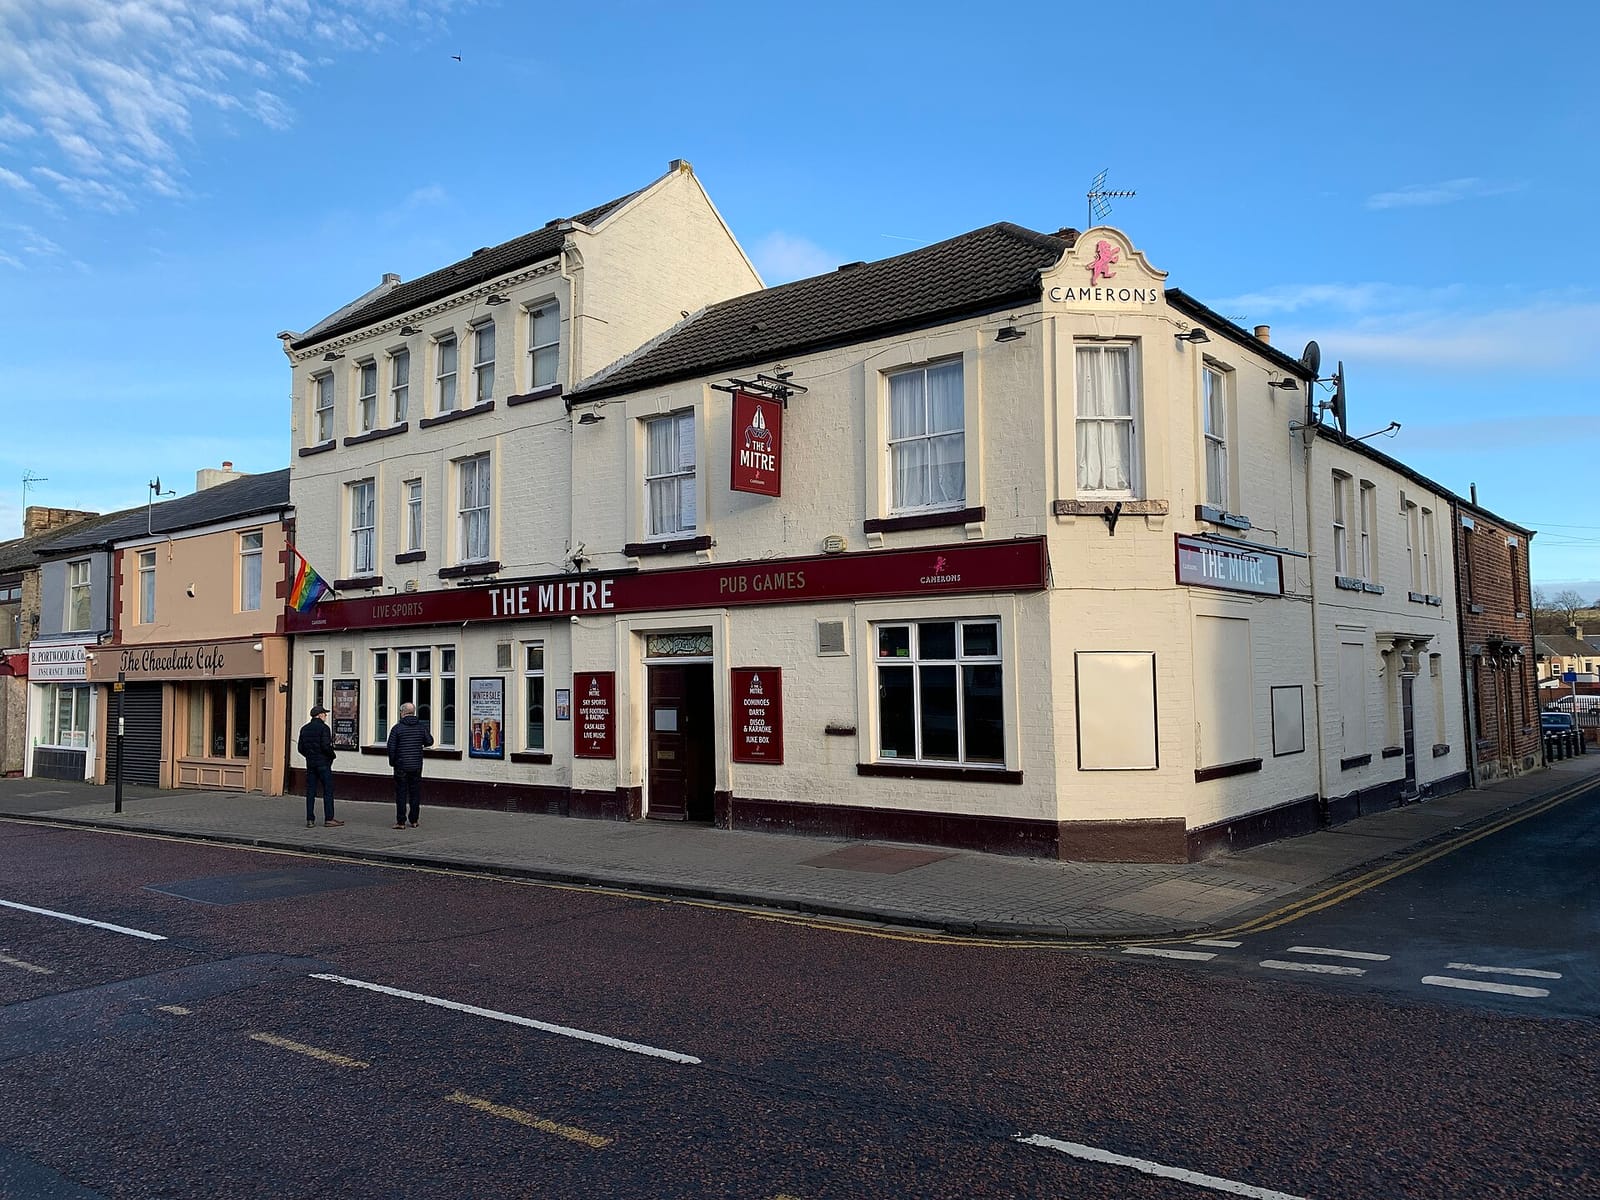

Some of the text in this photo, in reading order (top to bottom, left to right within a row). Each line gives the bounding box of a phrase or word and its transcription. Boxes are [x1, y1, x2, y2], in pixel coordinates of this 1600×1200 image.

[1050, 287, 1157, 302] CAMERONS
[752, 440, 765, 452] THE
[740, 449, 775, 471] MITRE
[1200, 548, 1264, 585] THE MITRE
[720, 571, 805, 593] PUB GAMES
[920, 574, 961, 584] CAMERONS
[488, 580, 614, 615] THE MITRE
[372, 602, 423, 618] LIVE SPORTS
[38, 651, 70, 662] PORTWOOD
[71, 650, 75, 661] &
[120, 646, 225, 675] The Chocolate Cafe
[39, 668, 63, 676] INSURANCE
